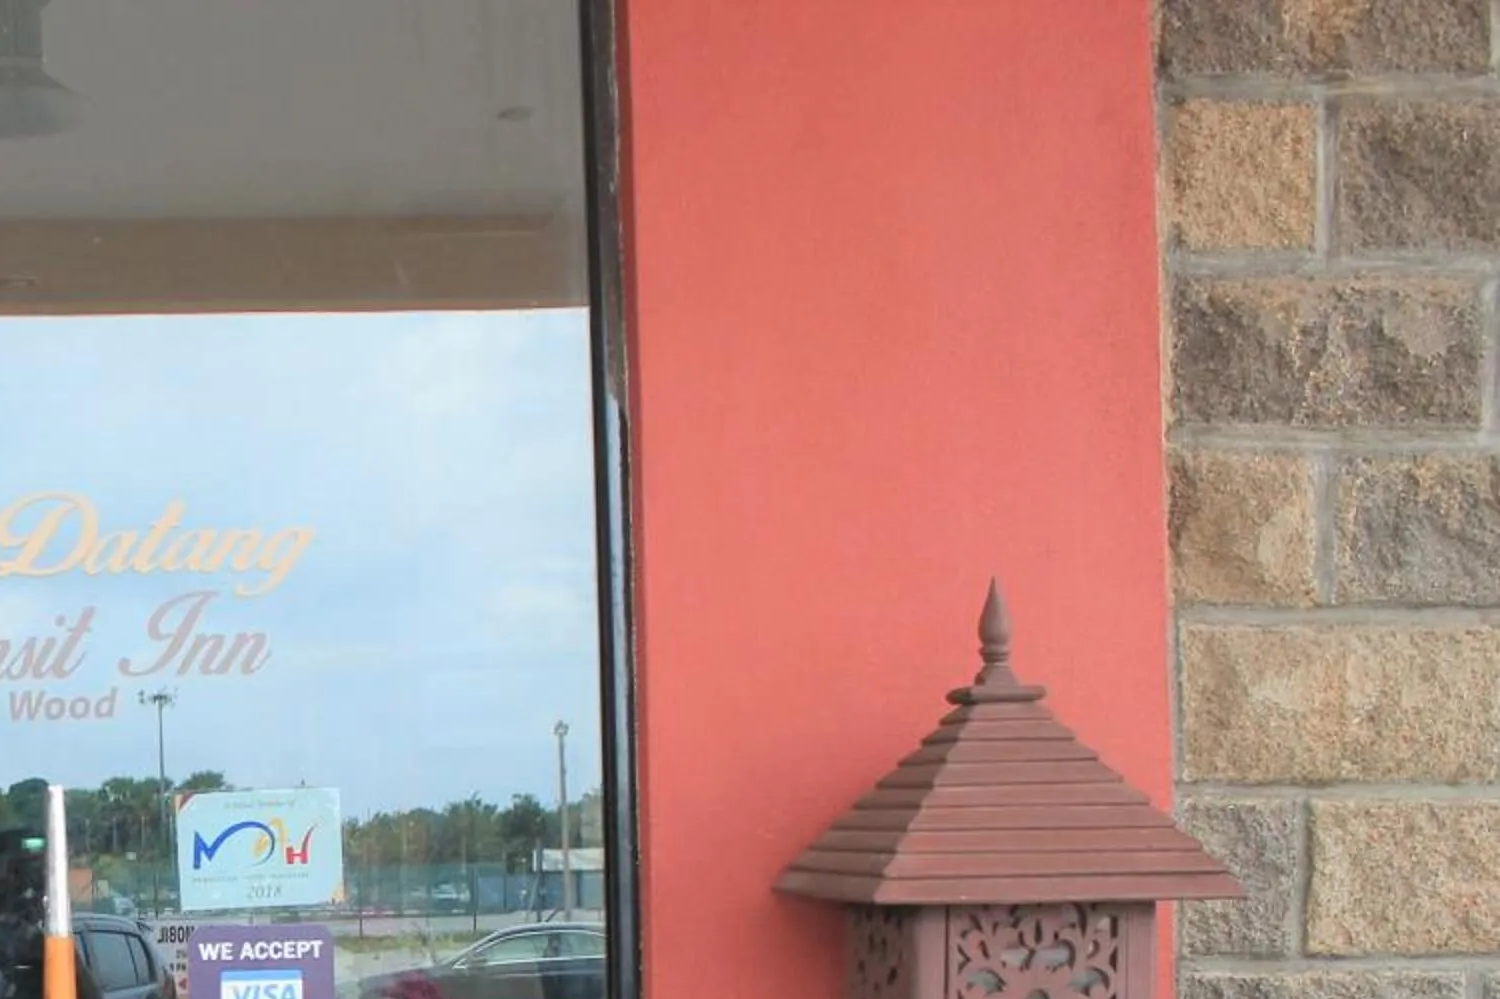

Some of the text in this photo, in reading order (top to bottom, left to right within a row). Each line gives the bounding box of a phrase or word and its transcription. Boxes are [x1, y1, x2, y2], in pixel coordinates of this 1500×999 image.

[119, 589, 273, 678] Inn
[9, 687, 117, 722] Wood
[198, 942, 232, 961] WE
[240, 940, 323, 960] ACCEPT
